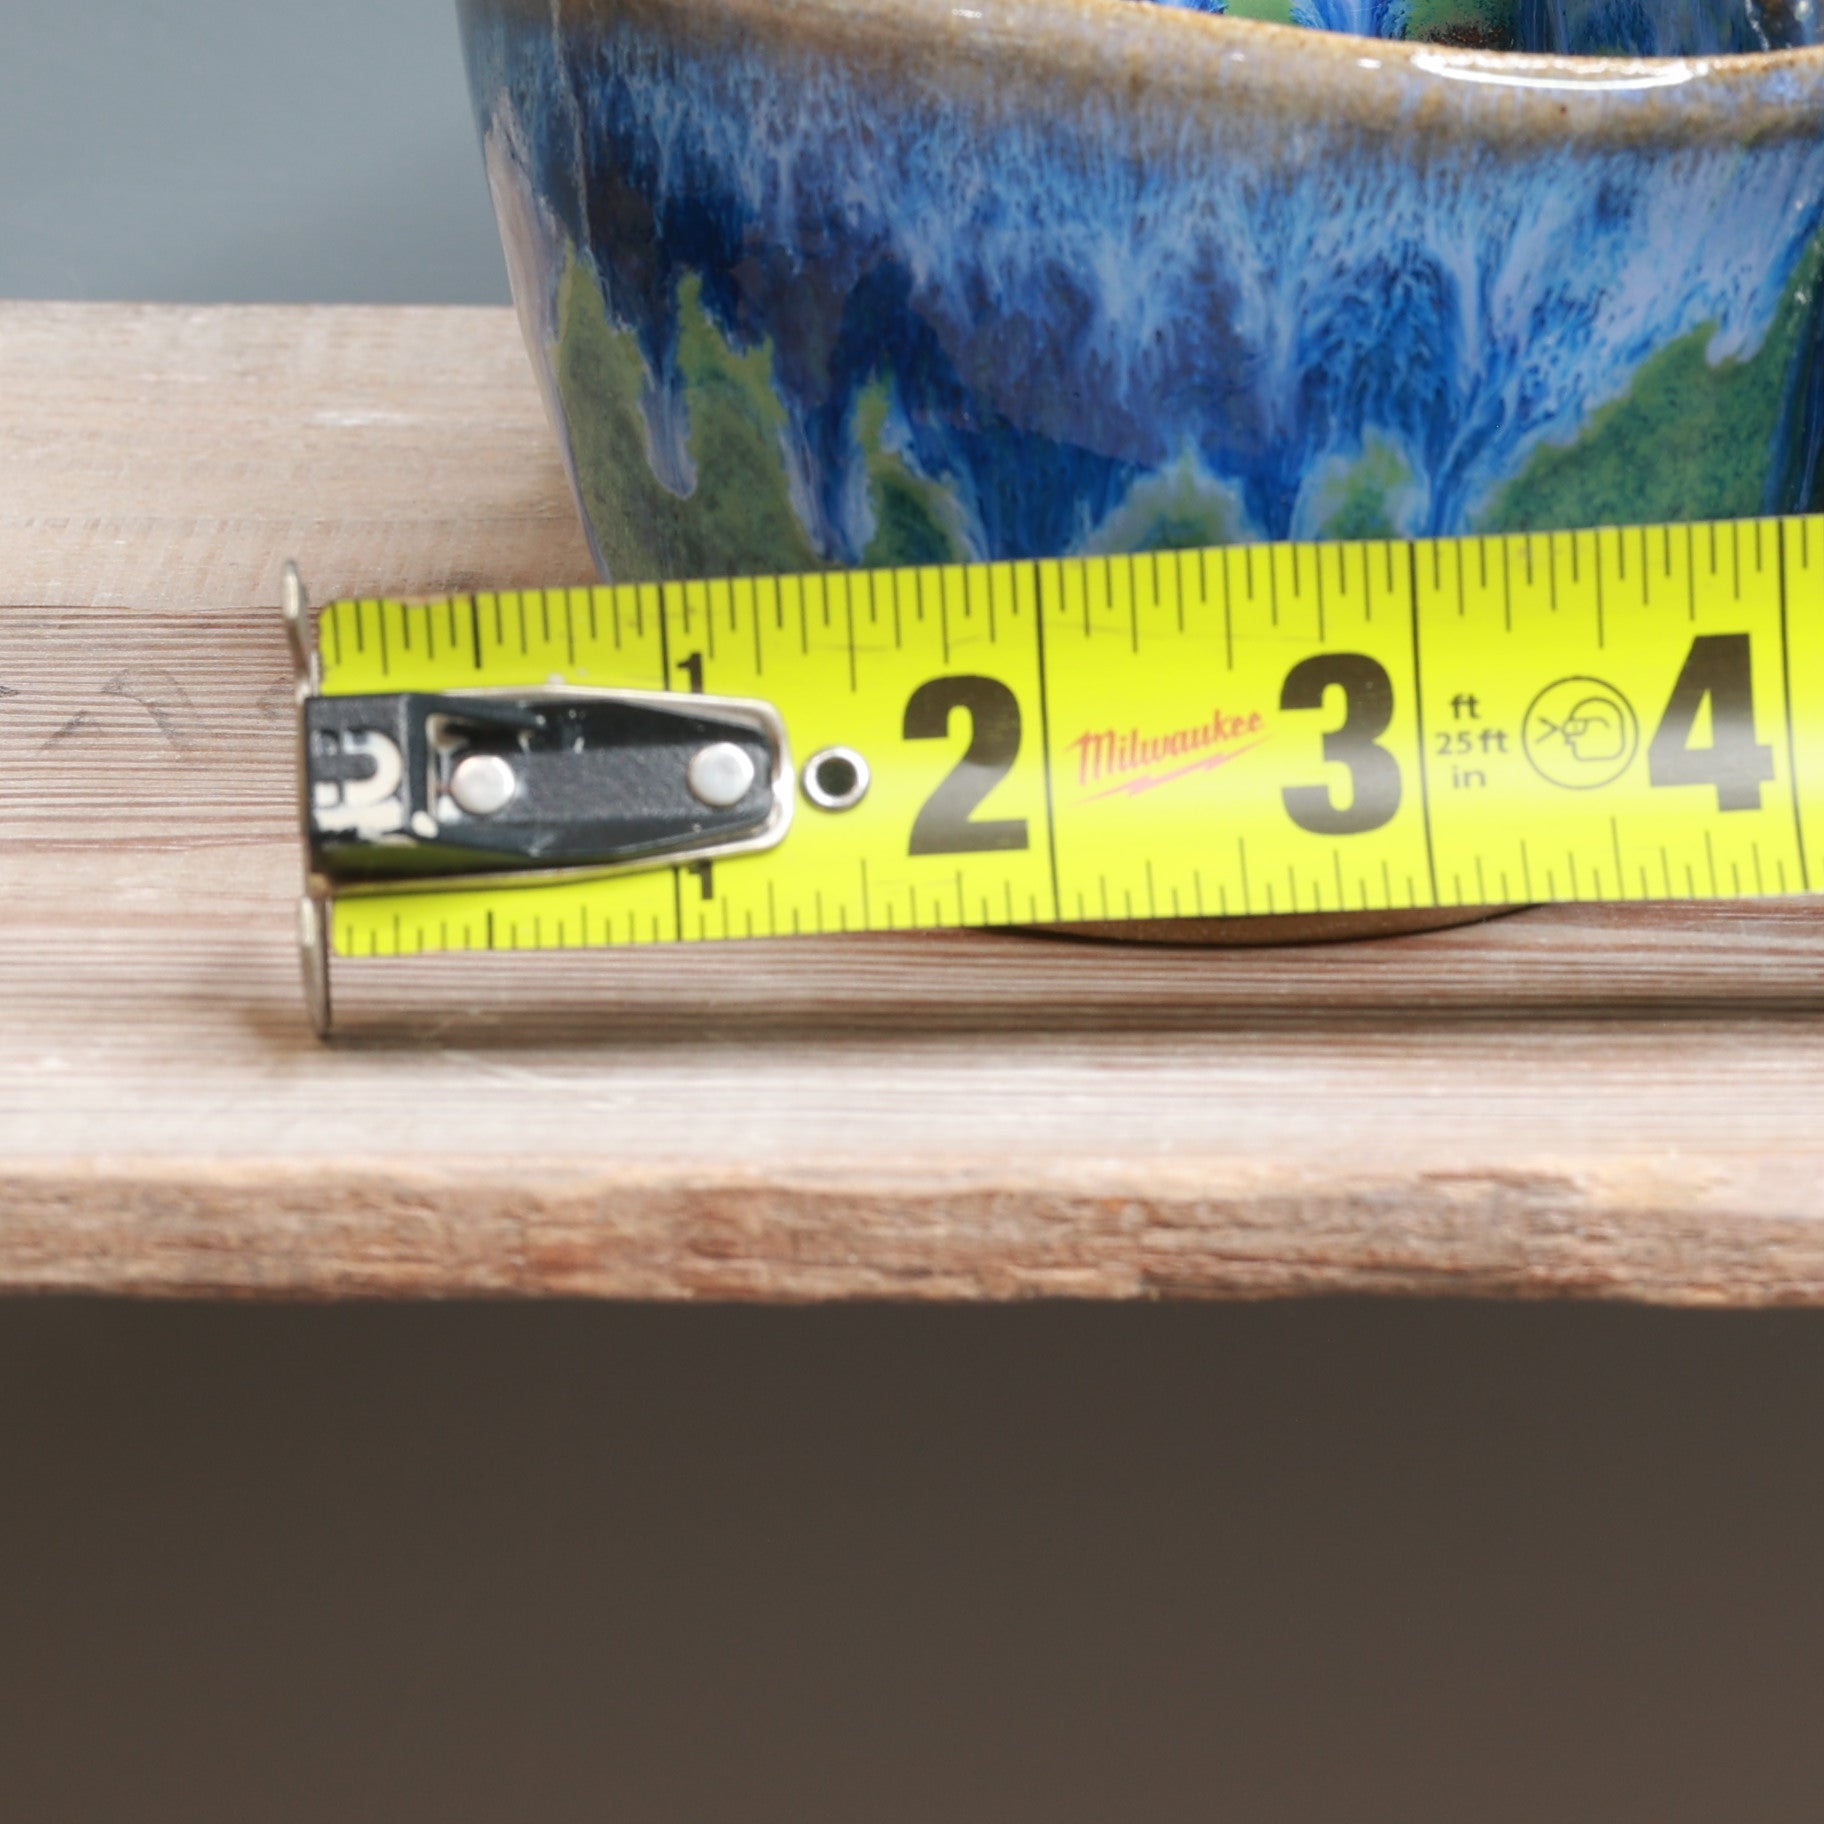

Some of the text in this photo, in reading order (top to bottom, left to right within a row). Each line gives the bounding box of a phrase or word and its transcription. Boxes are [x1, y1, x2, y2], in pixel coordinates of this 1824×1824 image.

[676, 651, 704, 694] 1
[1450, 692, 1481, 720] ft
[1647, 631, 1775, 812] 4
[902, 673, 1030, 856] 2
[1066, 708, 1267, 786] Milwaukee
[1279, 651, 1402, 836] 3
[1435, 729, 1509, 755] 25 ft
[1452, 764, 1487, 789] in
